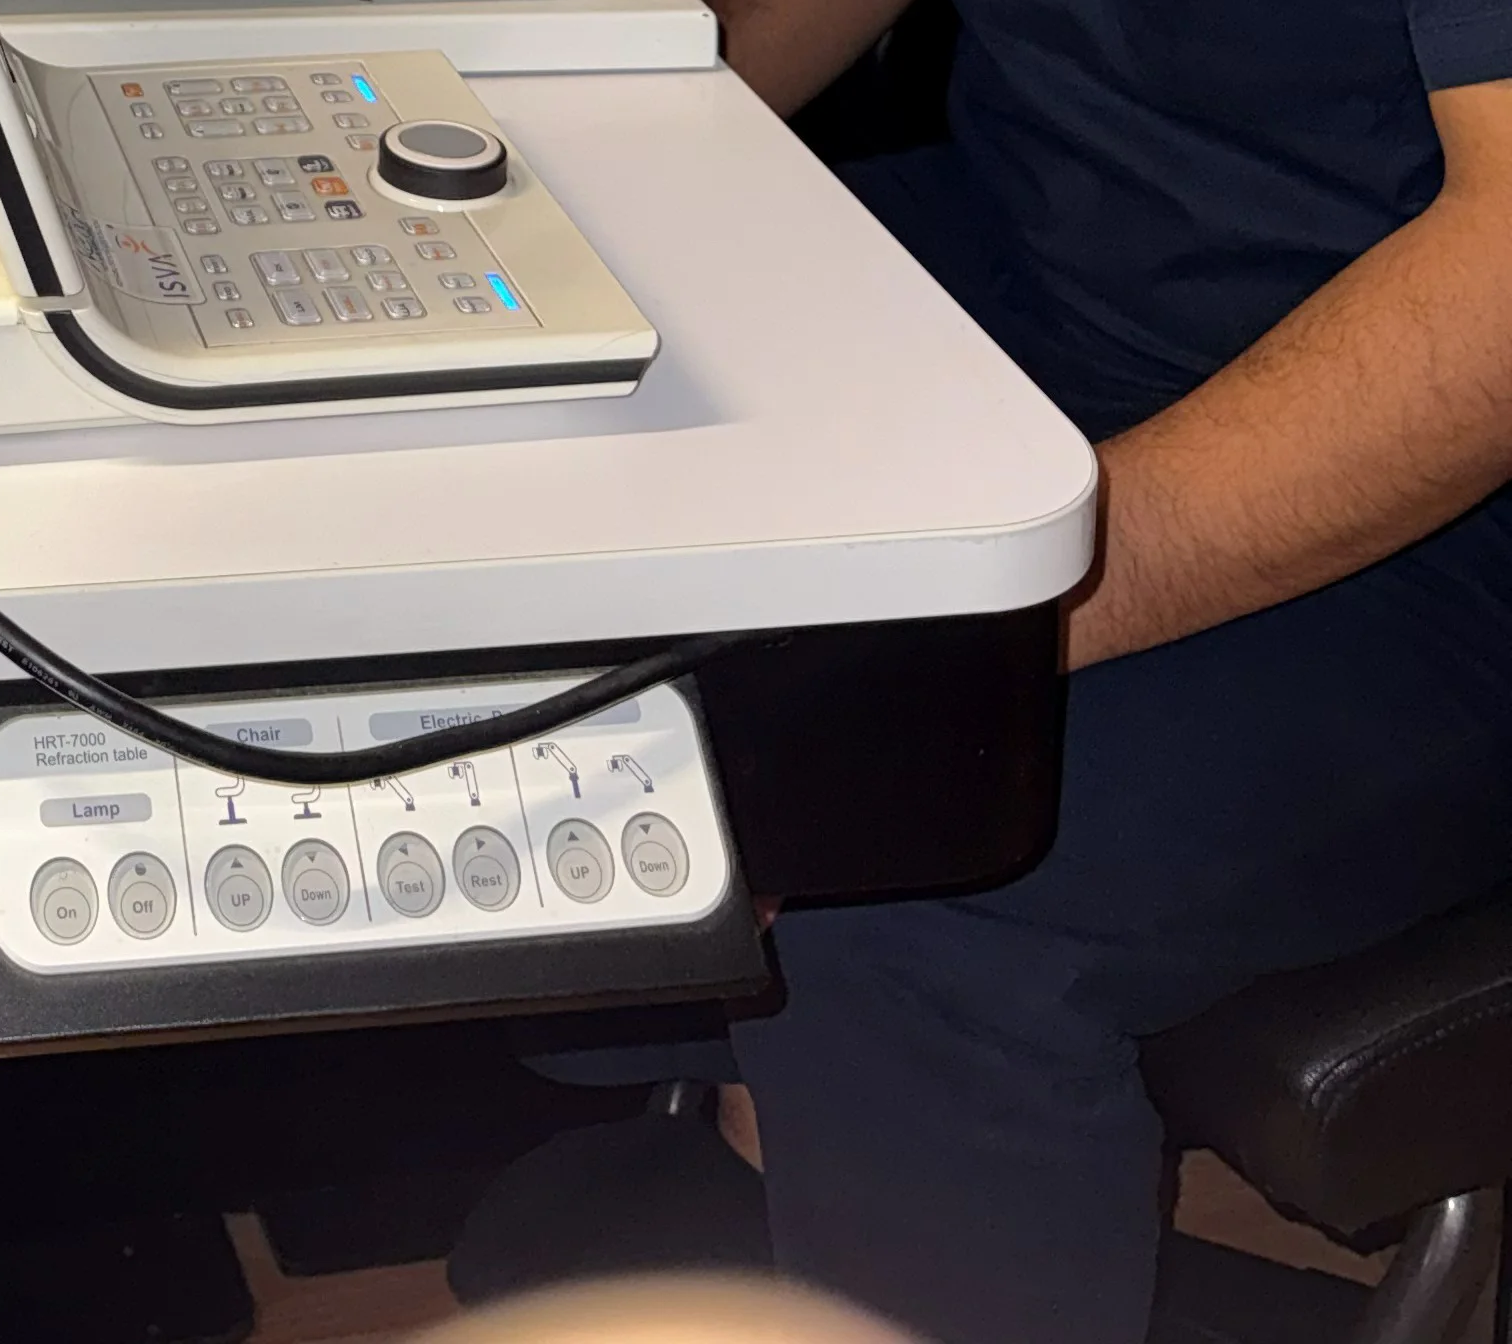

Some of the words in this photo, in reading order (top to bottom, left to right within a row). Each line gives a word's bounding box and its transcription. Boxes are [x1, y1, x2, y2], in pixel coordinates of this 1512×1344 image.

[33, 732, 106, 750] HRT-7000
[236, 727, 281, 745] Chair
[35, 749, 110, 767] Refraction
[113, 746, 148, 762] table
[72, 803, 120, 821] Lamp
[570, 866, 590, 880] UP
[639, 860, 670, 874] Down
[395, 879, 426, 894] Test
[471, 873, 503, 888] Rest
[231, 893, 251, 907] UP
[301, 889, 332, 902] Down
[56, 906, 77, 920] On
[132, 899, 154, 914] Off
